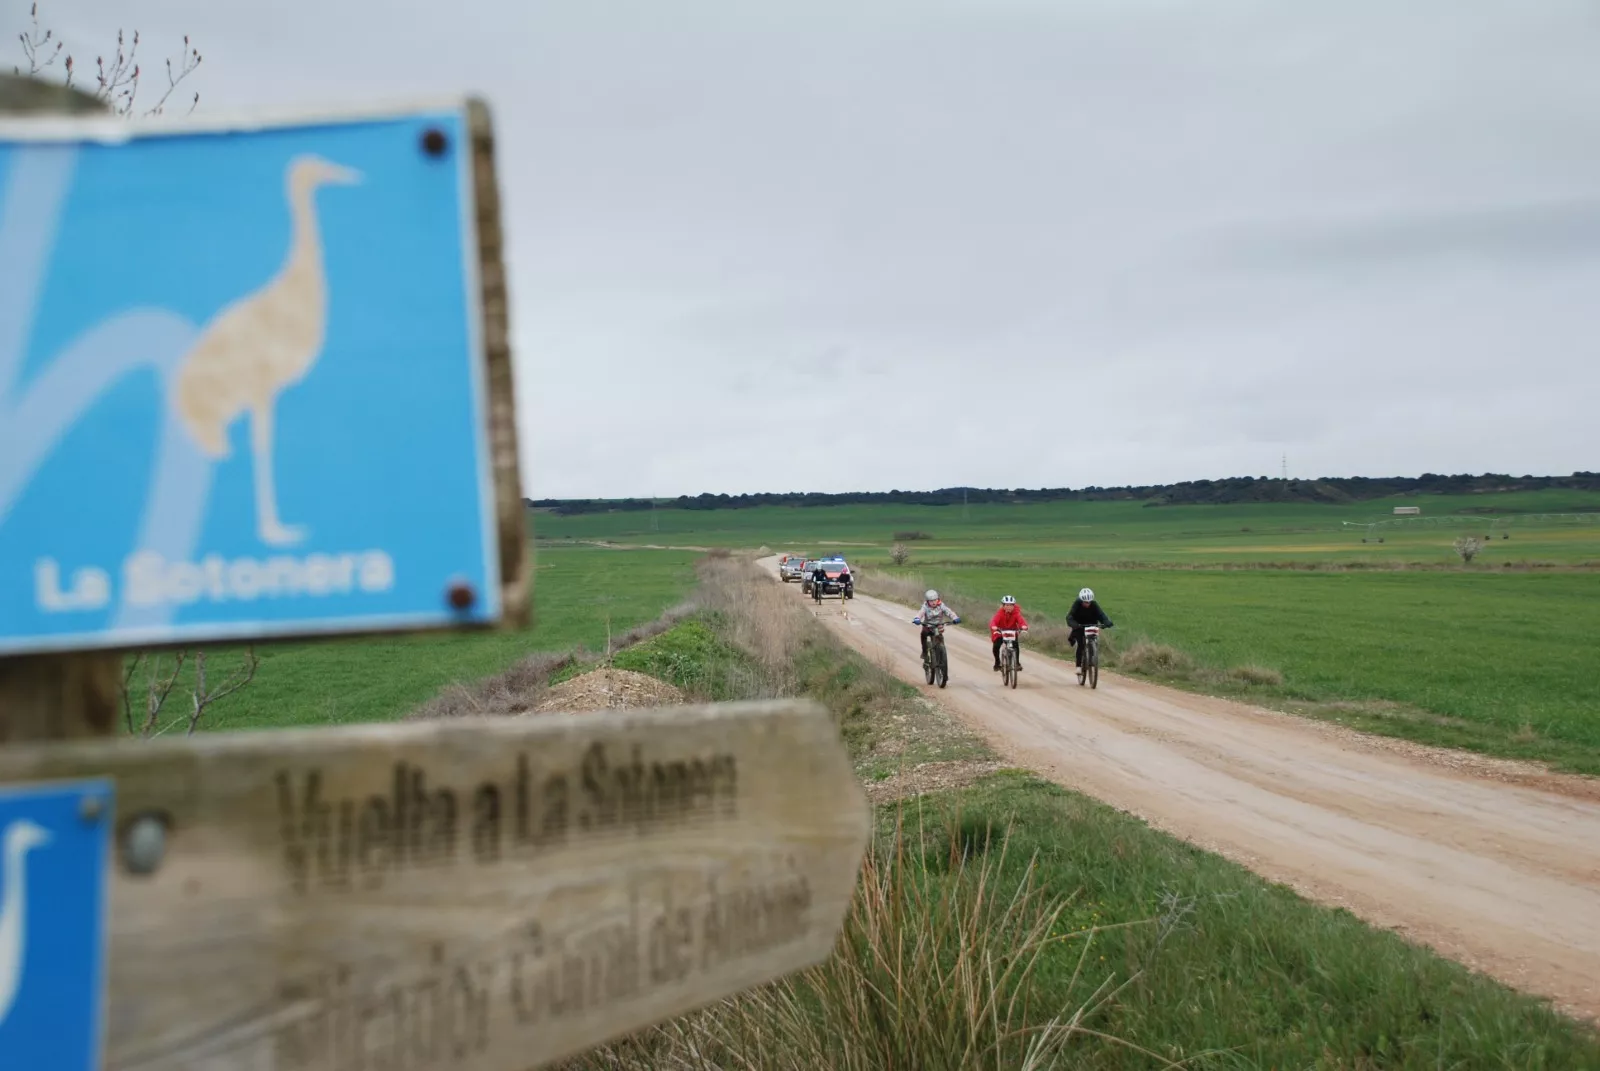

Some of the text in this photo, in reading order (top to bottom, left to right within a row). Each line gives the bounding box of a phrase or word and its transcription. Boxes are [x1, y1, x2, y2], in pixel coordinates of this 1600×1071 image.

[35, 556, 110, 612] La
[275, 759, 458, 892] Vuelta
[471, 782, 502, 864] a
[515, 751, 569, 850] La
